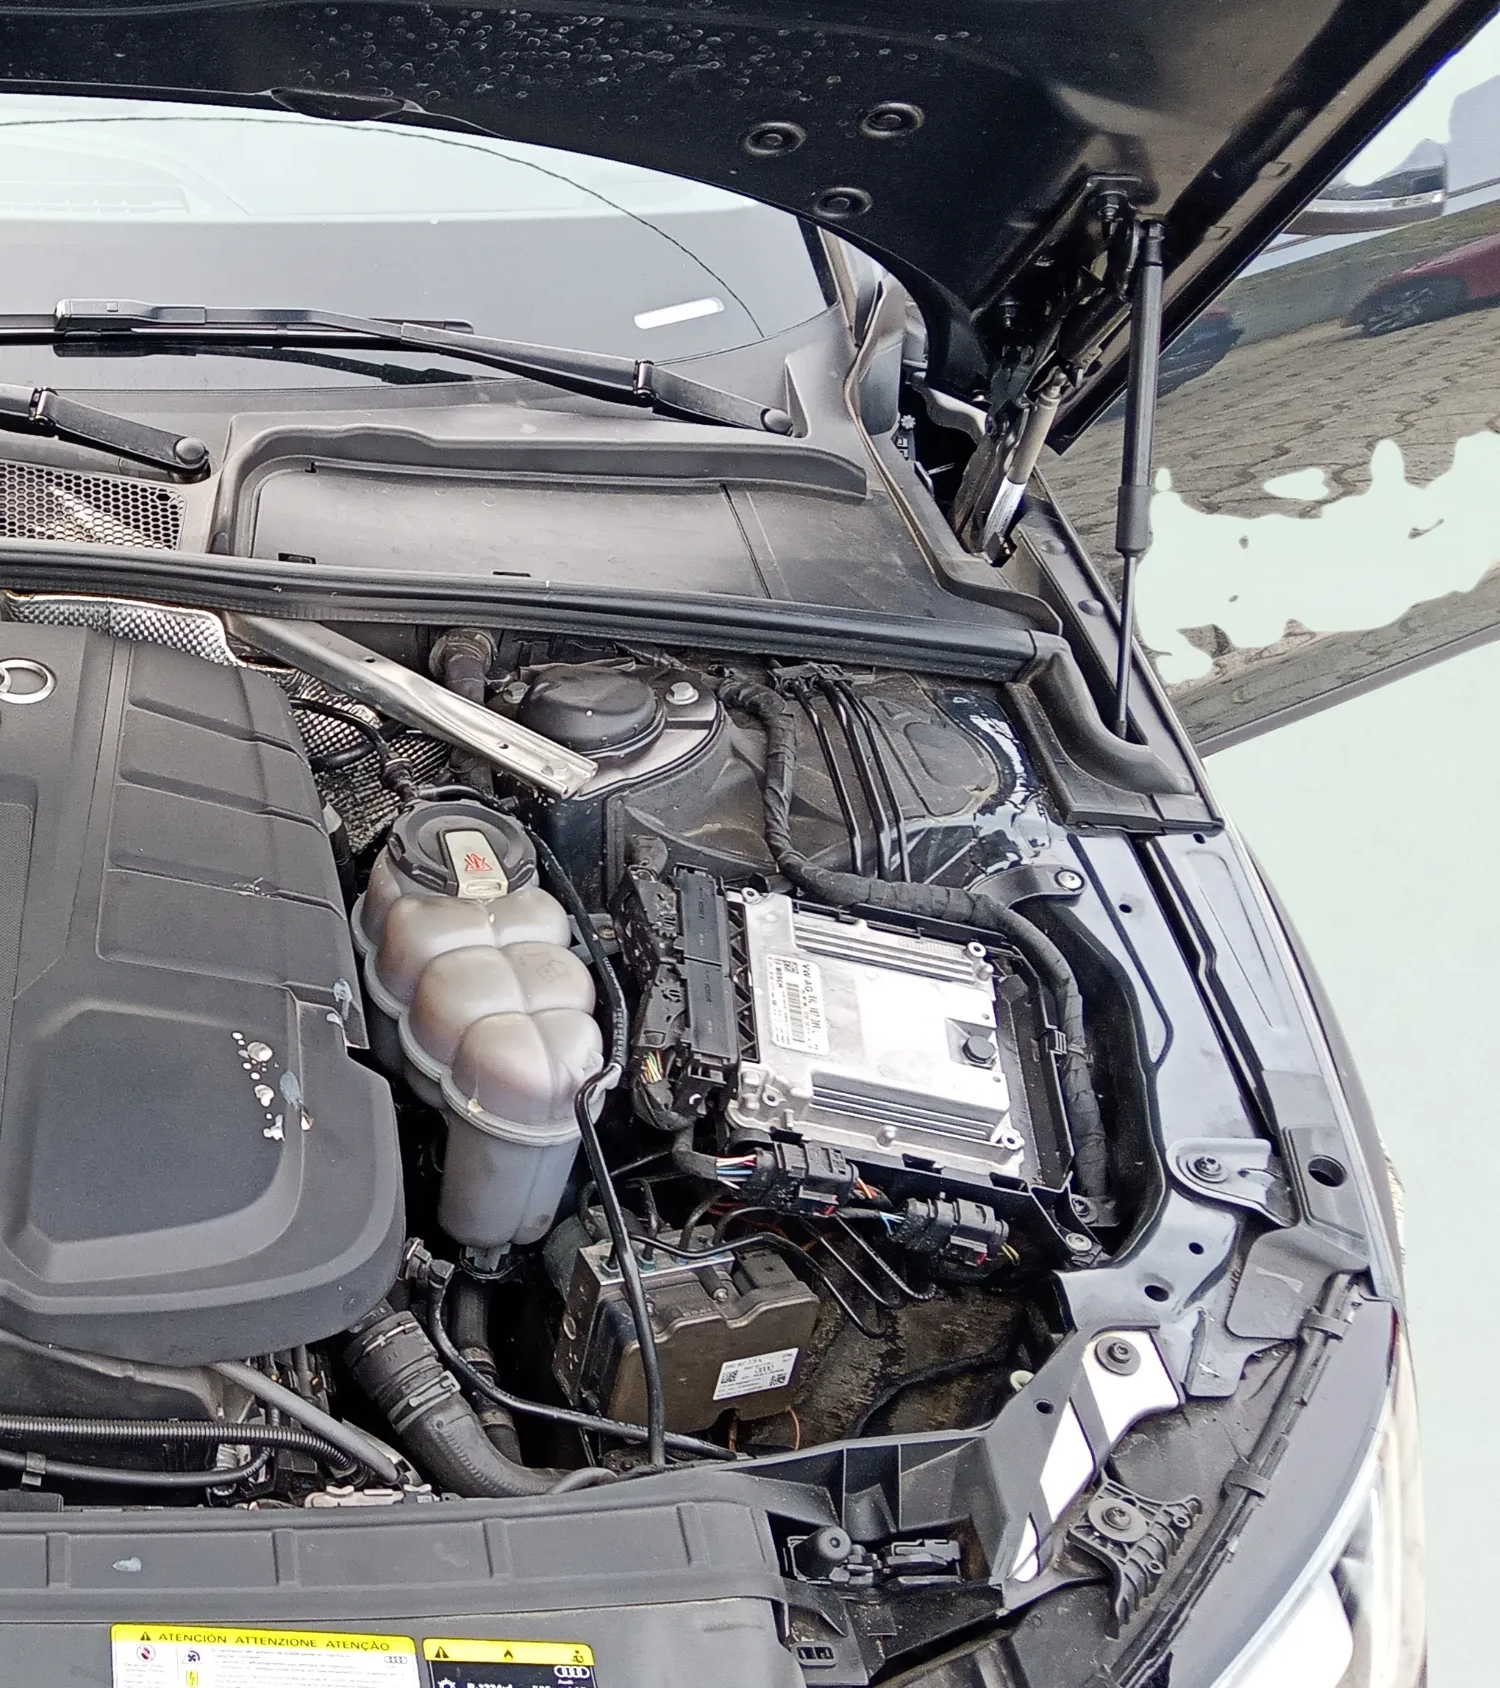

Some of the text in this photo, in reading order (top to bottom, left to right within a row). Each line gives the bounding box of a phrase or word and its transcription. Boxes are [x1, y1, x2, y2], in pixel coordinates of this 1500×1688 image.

[776, 967, 784, 988] BOSCH
[802, 964, 811, 979] VW
[803, 979, 814, 993] AG
[158, 1632, 390, 1651] ATENCIÓN ATTENZIONE ATENÇÃO
